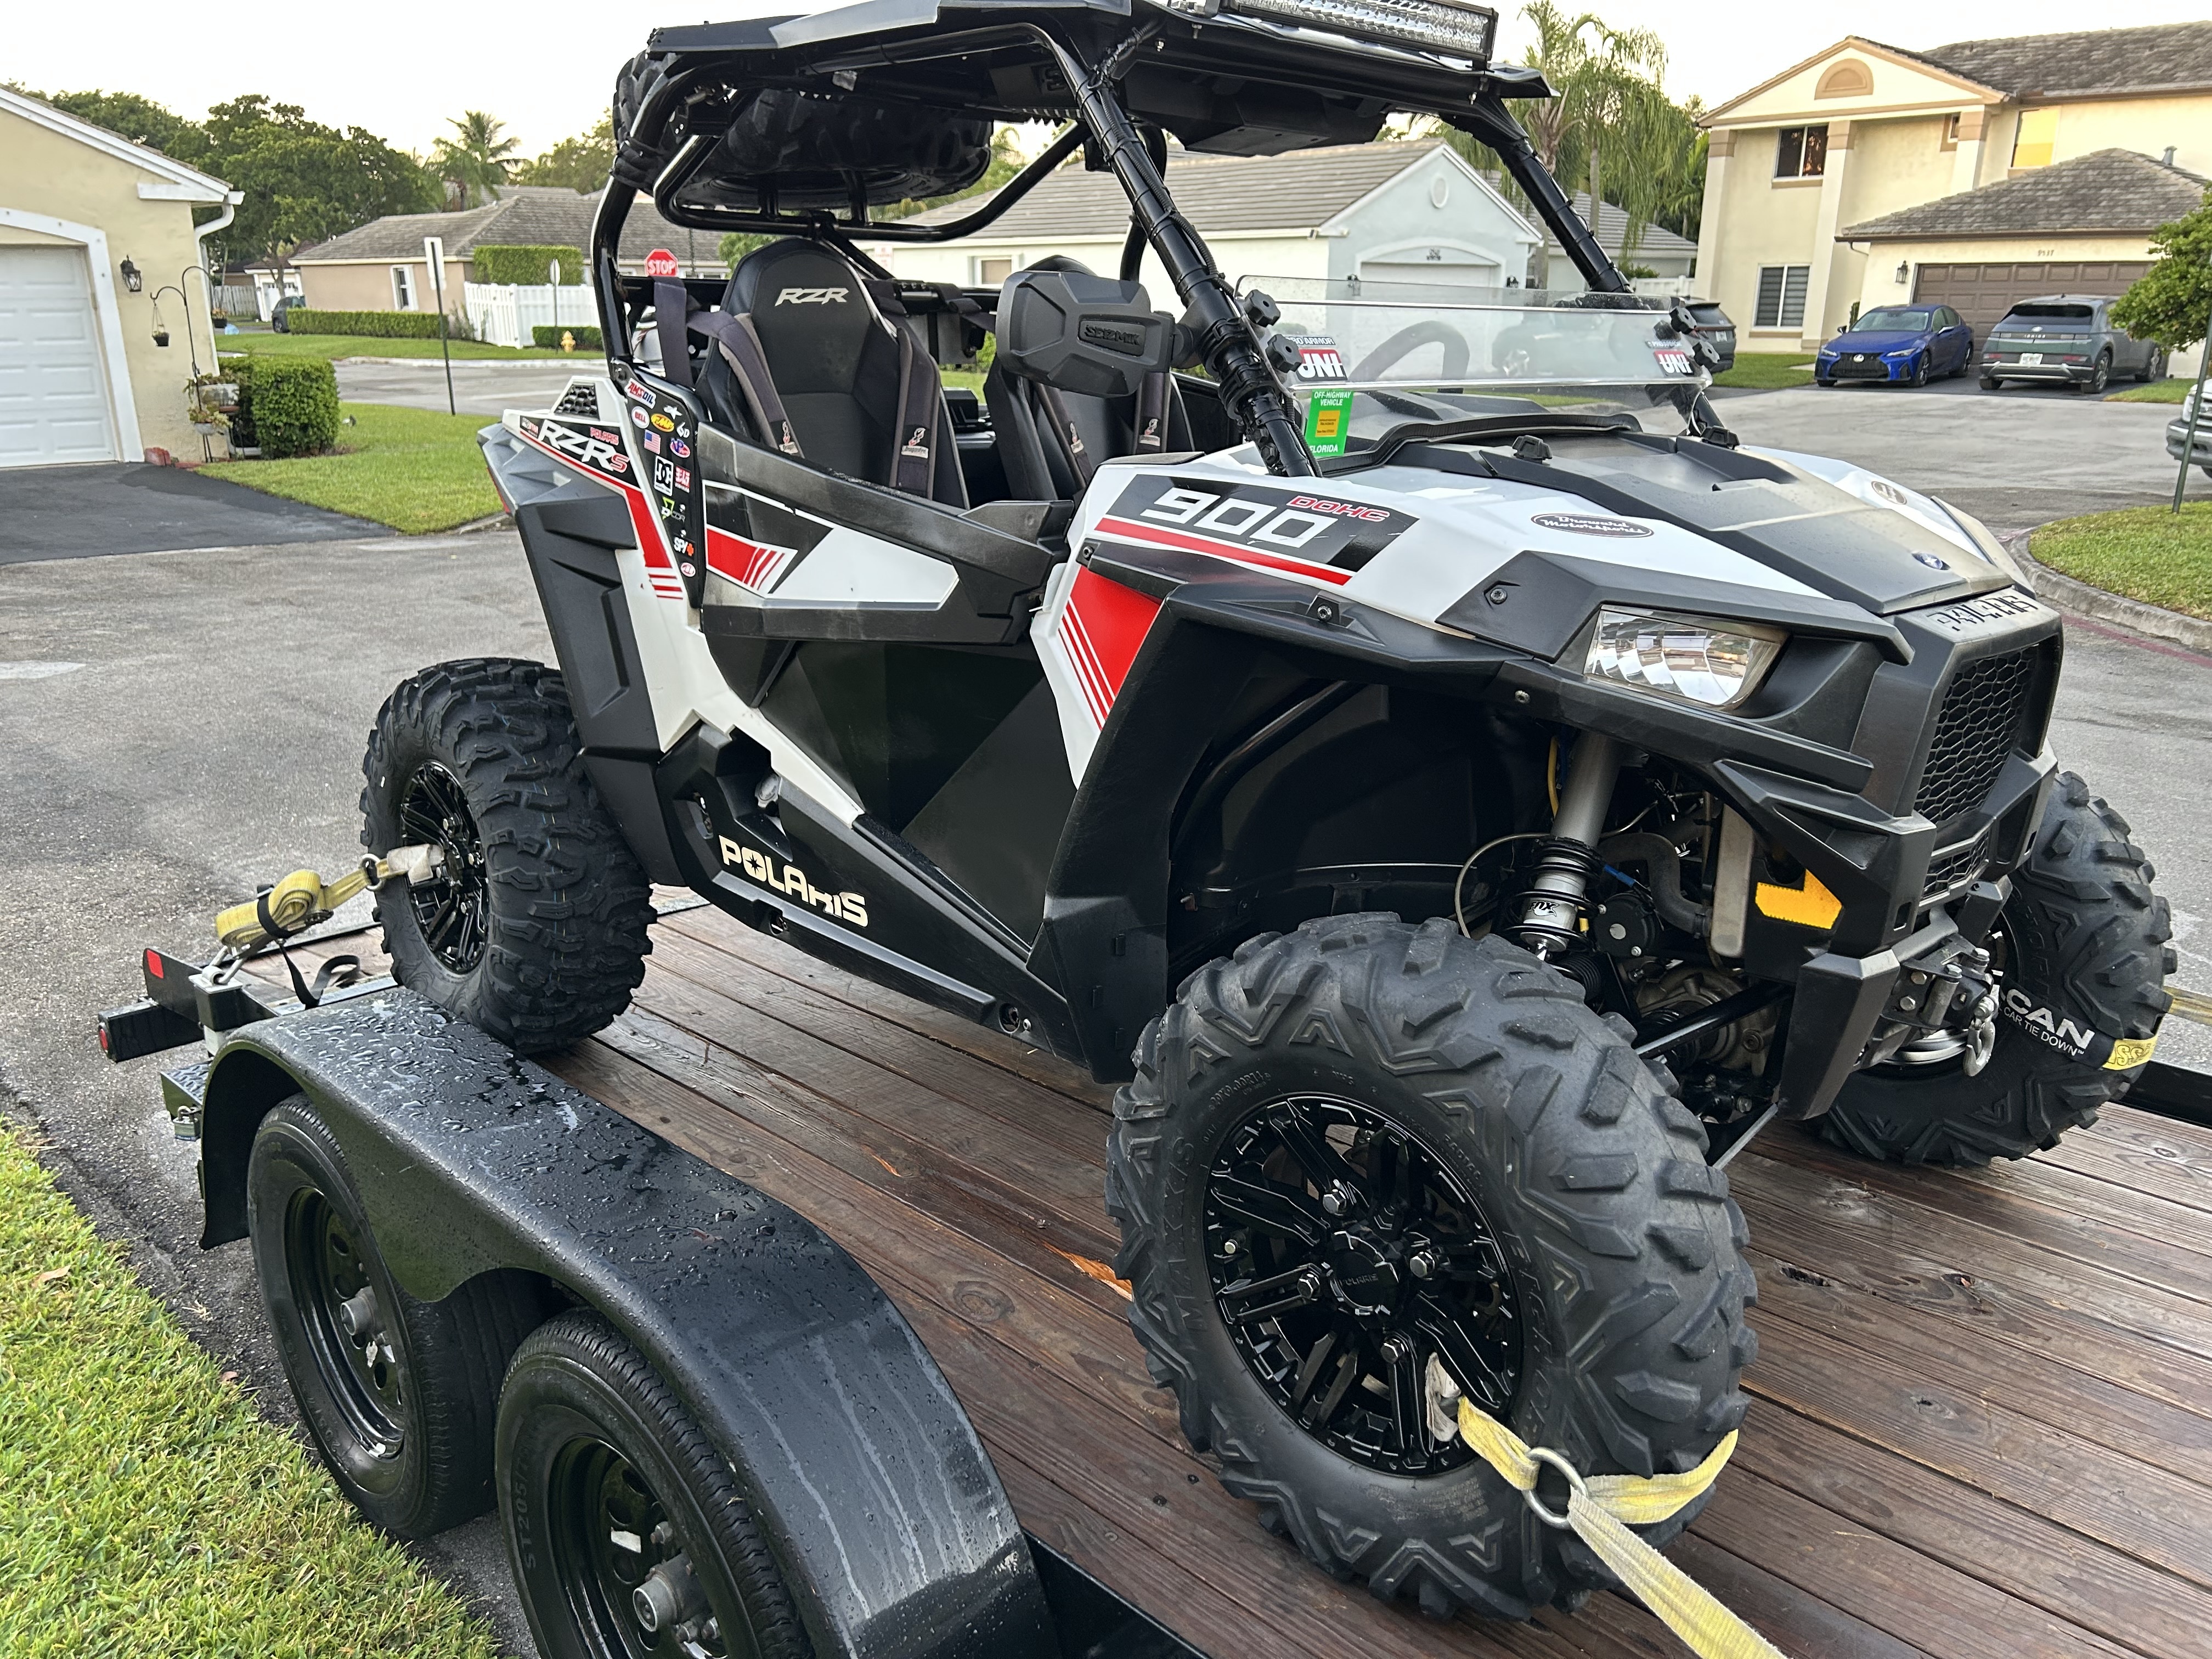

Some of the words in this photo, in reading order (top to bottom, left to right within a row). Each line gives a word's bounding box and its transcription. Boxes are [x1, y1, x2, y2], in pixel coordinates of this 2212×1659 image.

[648, 259, 675, 274] STOP
[775, 288, 849, 307] RZR
[1085, 324, 1140, 346] SEIZMIK
[1658, 354, 1691, 373] UNI
[628, 382, 653, 405] AMSOIL
[635, 411, 646, 424] BELL
[590, 427, 619, 445] POLARIS
[1310, 444, 1338, 453] FLORIDA
[1139, 487, 1339, 548] 900
[1286, 495, 1390, 522] DOHC
[1540, 520, 1646, 533] Motorsports
[1554, 516, 1630, 528] Broward
[719, 835, 868, 927] POLARIS
[1527, 901, 1558, 912] FOX
[2004, 1007, 2022, 1026] CAR
[2024, 1020, 2040, 1037] TIE
